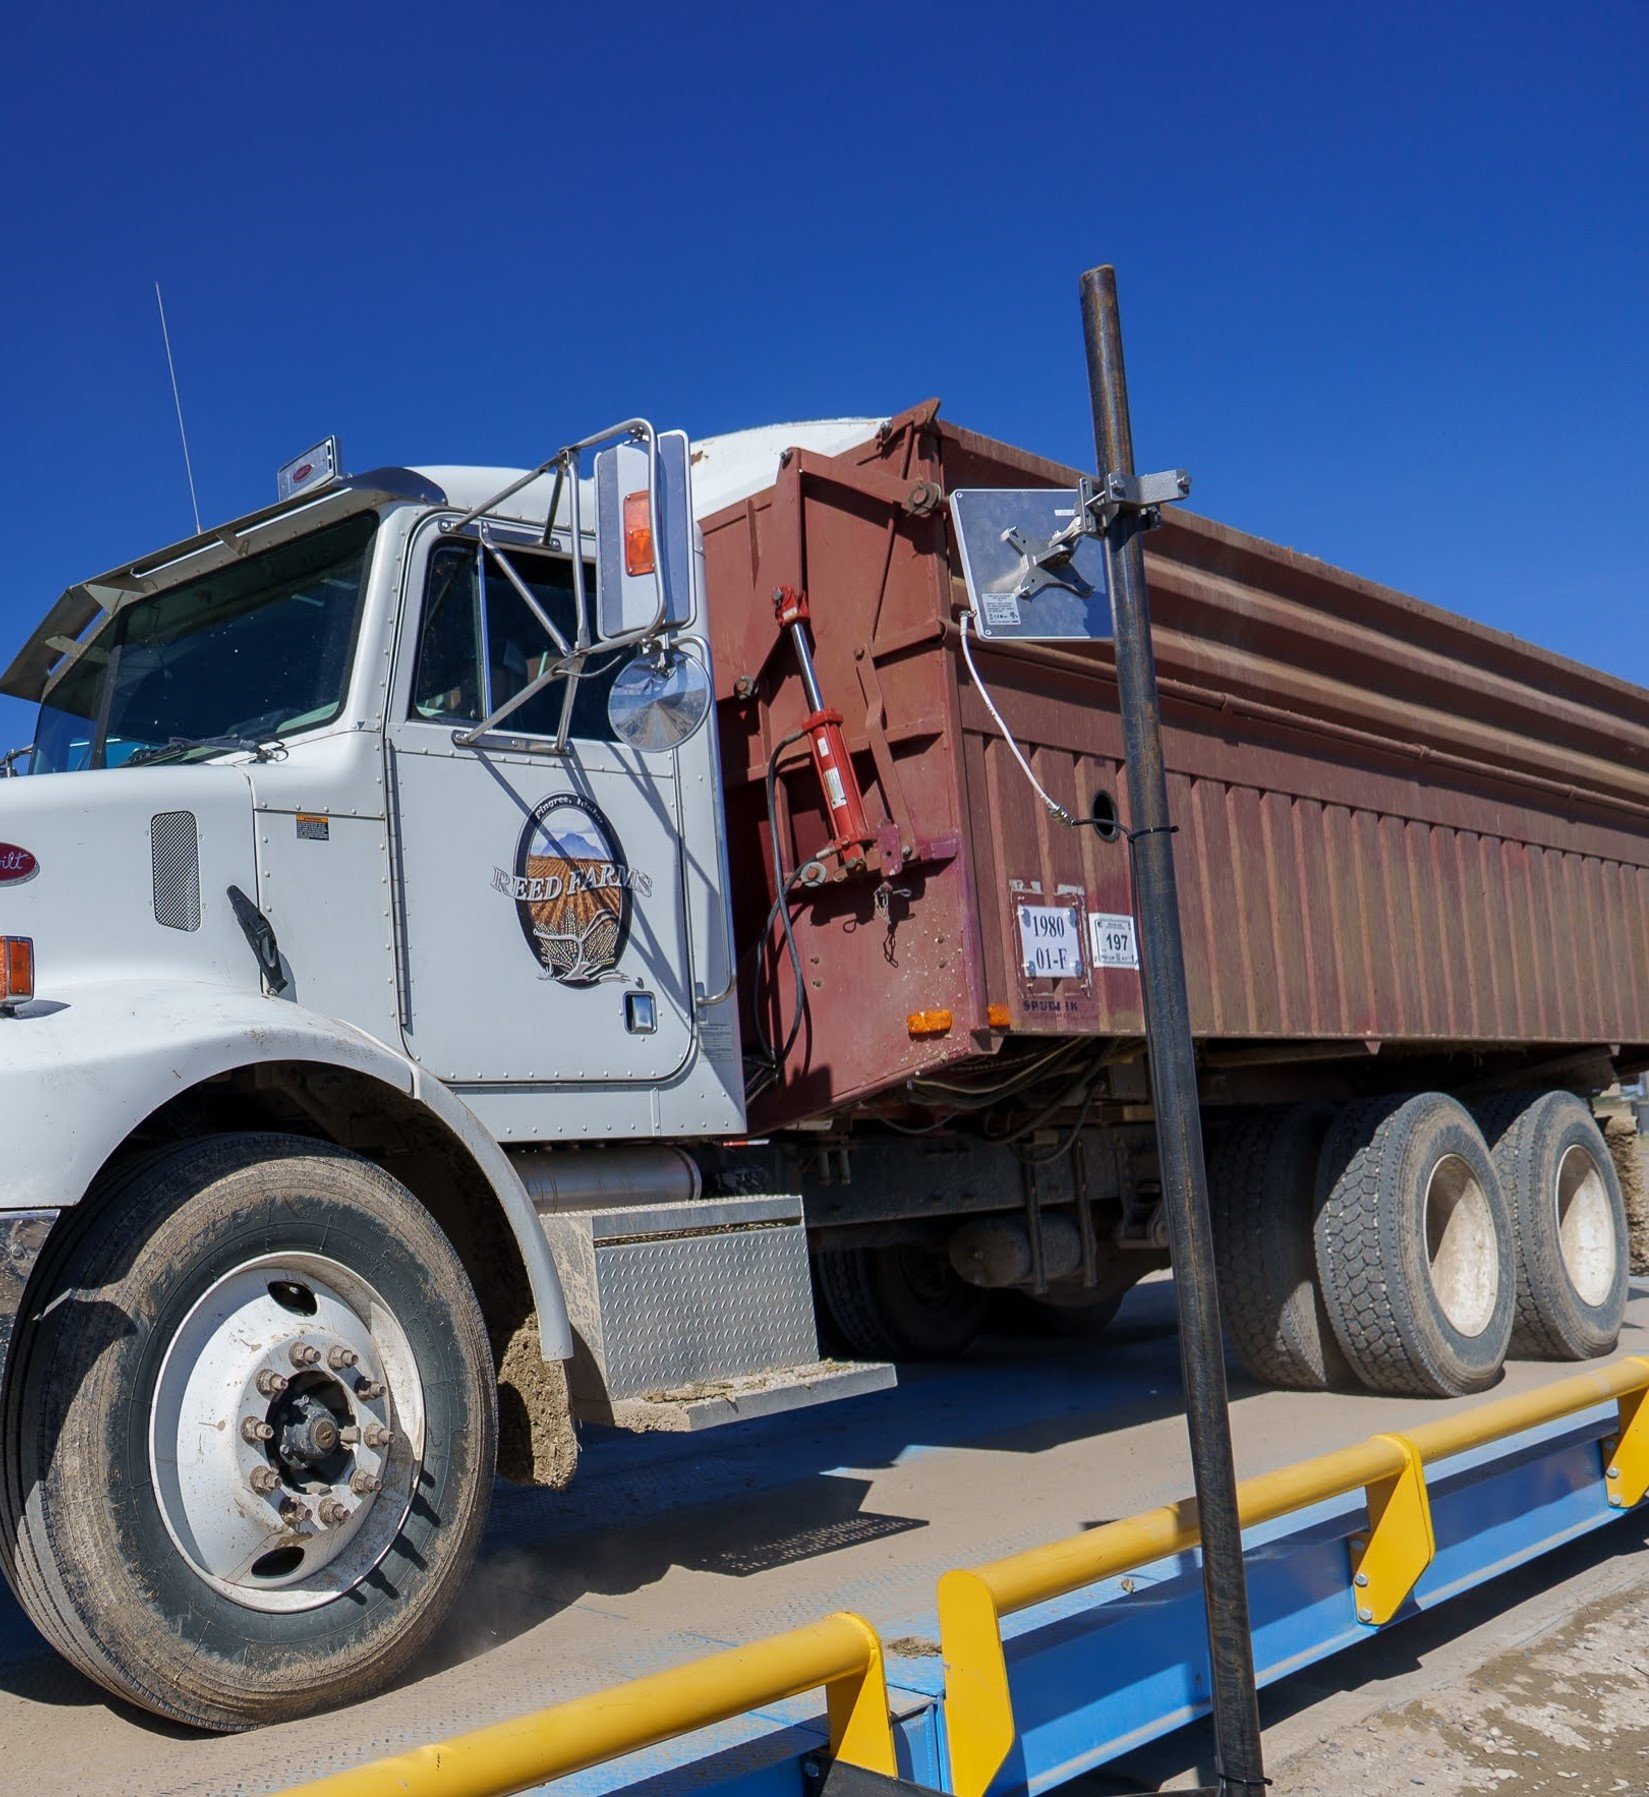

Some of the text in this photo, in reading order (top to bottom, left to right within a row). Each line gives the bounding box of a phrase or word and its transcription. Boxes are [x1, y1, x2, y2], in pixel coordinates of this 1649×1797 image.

[490, 864, 653, 901] REED FARMS
[1033, 915, 1065, 938] 1980
[1106, 933, 1128, 952] 197
[1036, 947, 1068, 970] 01-F
